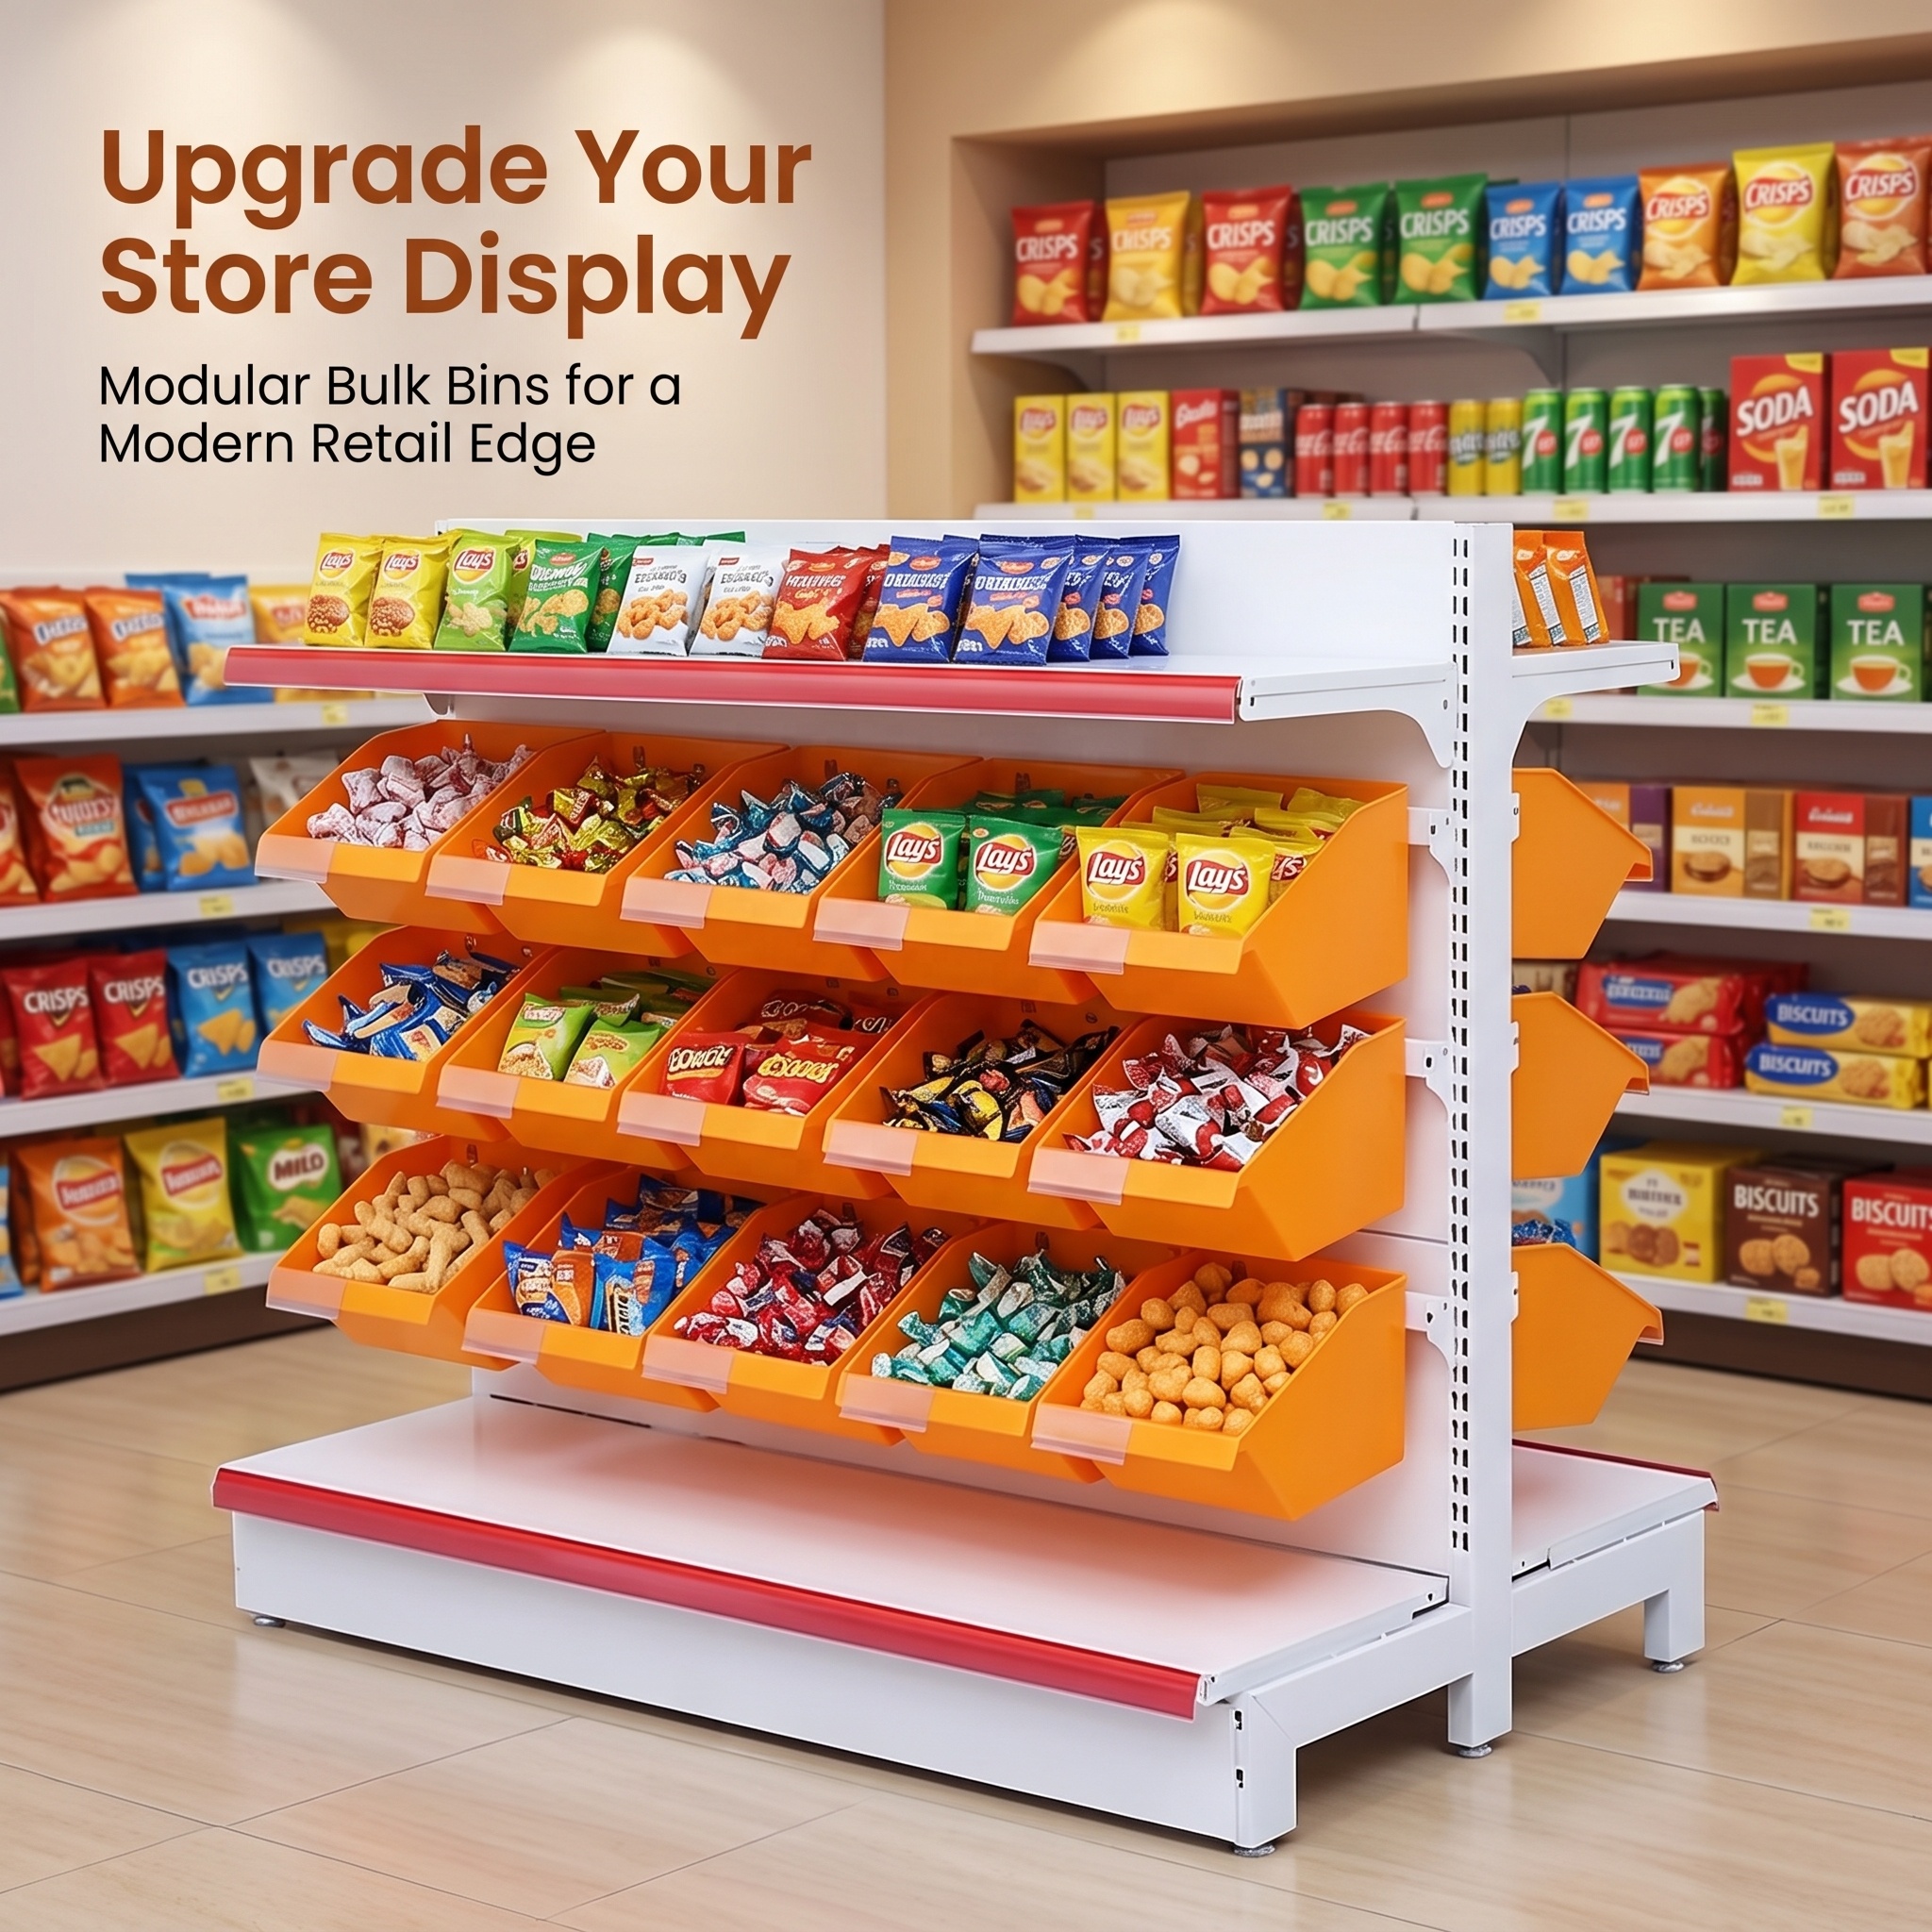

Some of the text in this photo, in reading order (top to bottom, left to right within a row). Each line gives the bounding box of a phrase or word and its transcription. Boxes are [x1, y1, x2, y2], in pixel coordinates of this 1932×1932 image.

[1745, 178, 1811, 208] CRISPS
[1845, 171, 1915, 201] CRISPS
[1567, 208, 1626, 234] CRISPS
[1646, 193, 1709, 221] CRISPS
[1207, 220, 1275, 250] CRISPS
[1305, 217, 1374, 246] CRISPS
[1400, 208, 1470, 239] CRISPS
[1490, 214, 1547, 241] CRISPS
[1015, 233, 1079, 262] CRISPS
[1111, 226, 1173, 253] CRISPS
[1736, 385, 1814, 437] SODA
[1839, 380, 1919, 433] SODA
[1653, 617, 1706, 644] TEA
[1741, 618, 1798, 645] TEA
[1846, 620, 1905, 646] TEA
[188, 963, 248, 989] CRISPS
[266, 955, 326, 980] CRISPS
[23, 986, 89, 1014] CRISPS
[104, 976, 165, 1004] CRISPS
[1776, 1003, 1849, 1027] BISCUITS
[1758, 1053, 1832, 1078] BISCUITS
[274, 1152, 325, 1181] MILO
[1734, 1184, 1820, 1219] BISCUITS
[1851, 1196, 1932, 1231] BISCUIT
